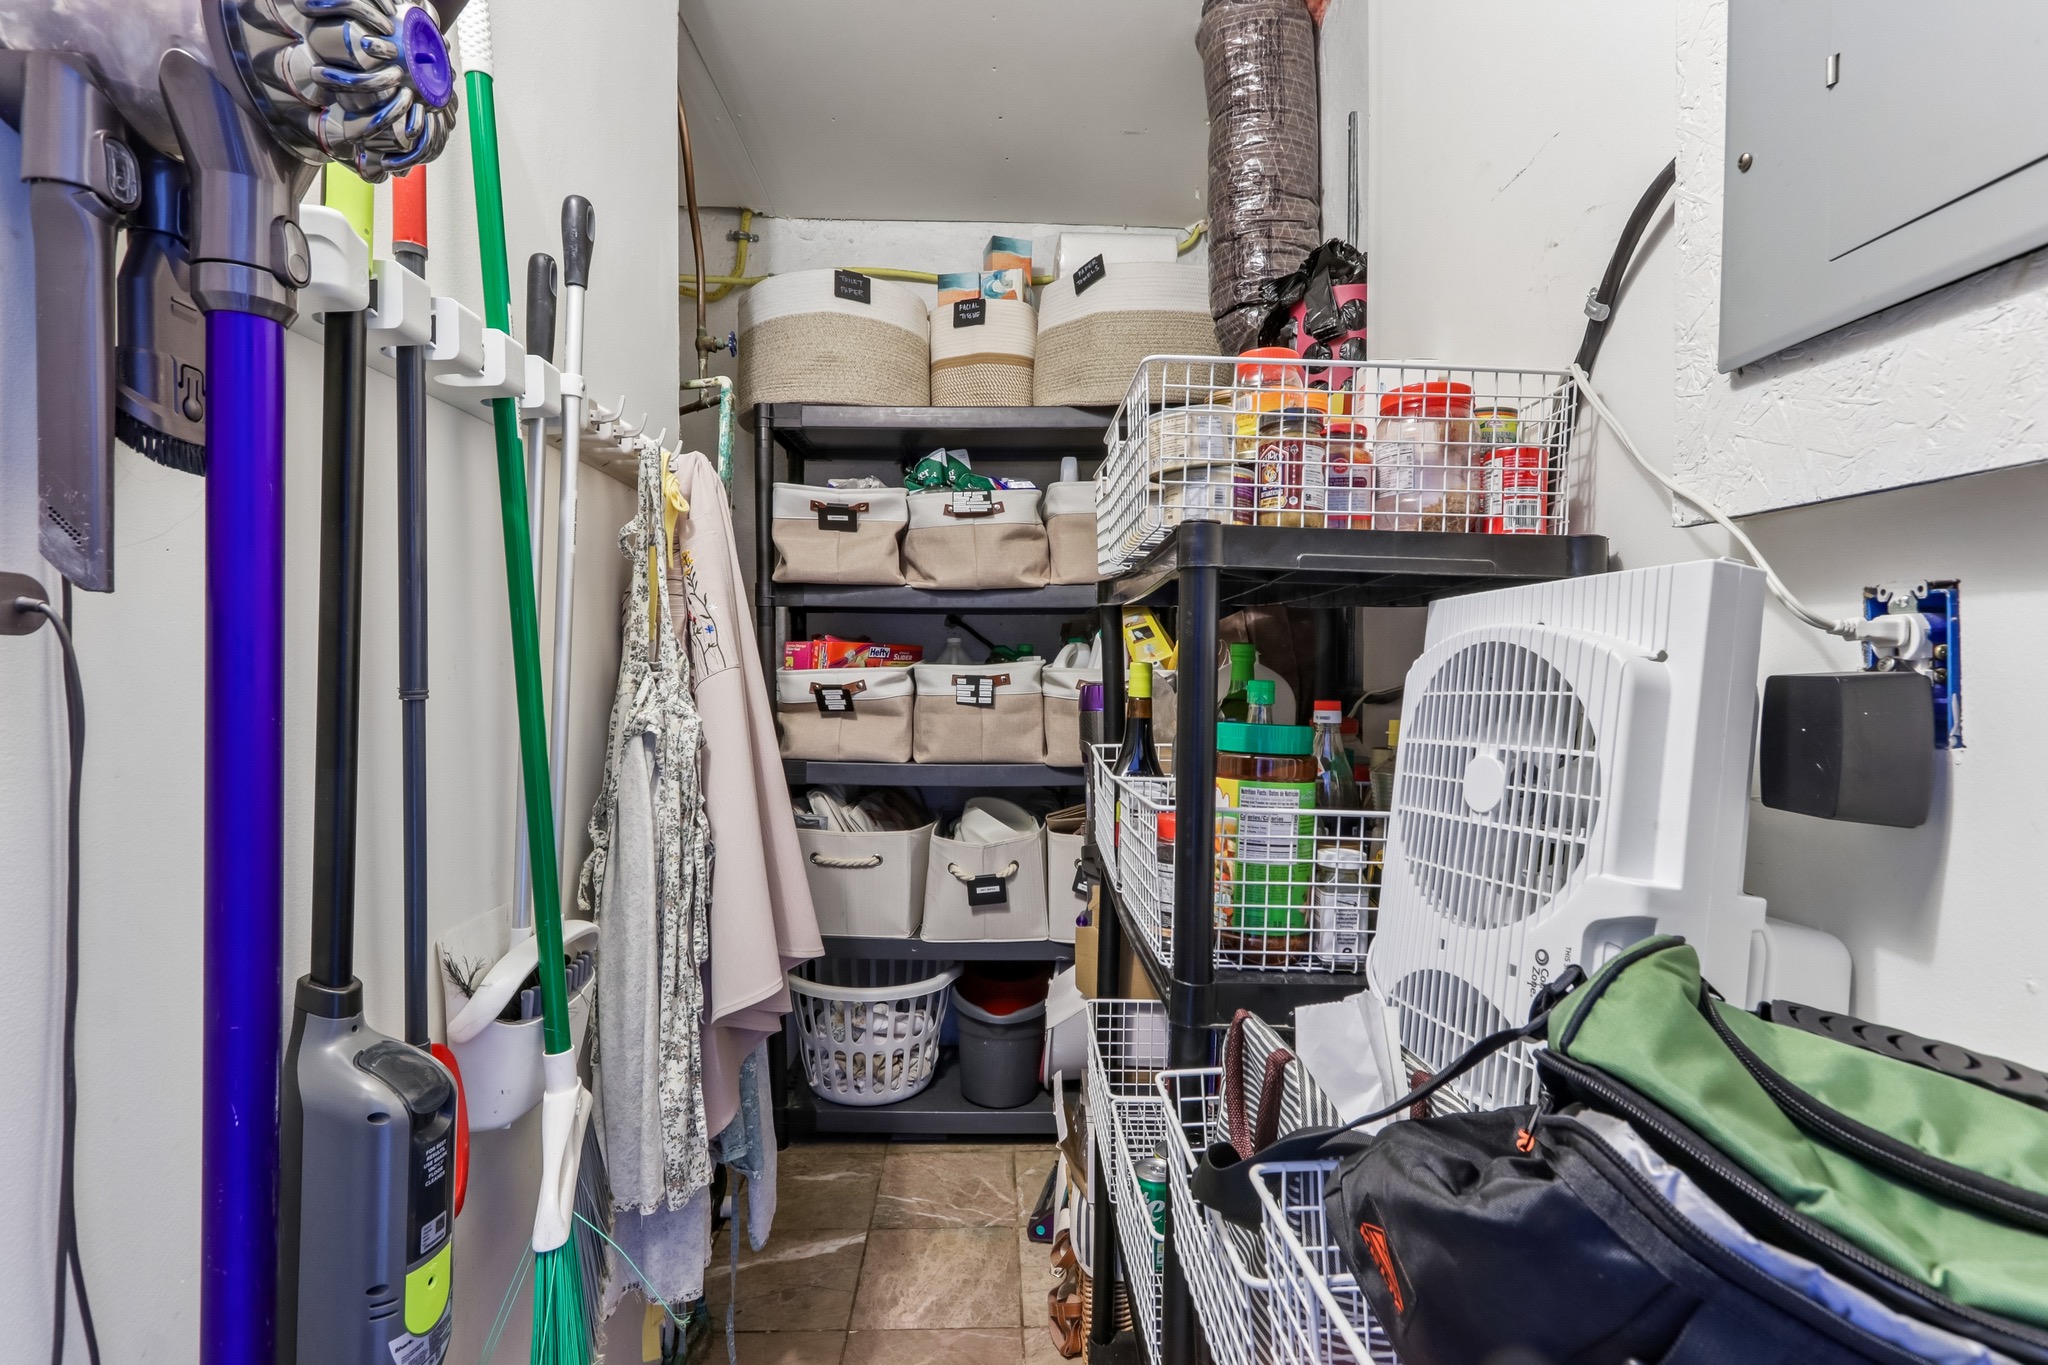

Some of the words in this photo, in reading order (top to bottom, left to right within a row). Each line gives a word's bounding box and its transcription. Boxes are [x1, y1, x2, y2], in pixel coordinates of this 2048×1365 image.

[1078, 259, 1098, 277] PAPER
[1076, 264, 1100, 285] TOWELS
[838, 275, 864, 287] TOILET
[840, 286, 864, 297] PAPER
[959, 302, 980, 311] FACIAL
[959, 311, 981, 319] TISSUE
[870, 647, 890, 658] Hefty
[893, 653, 913, 661] SLIDER
[1564, 947, 1572, 962] THIS
